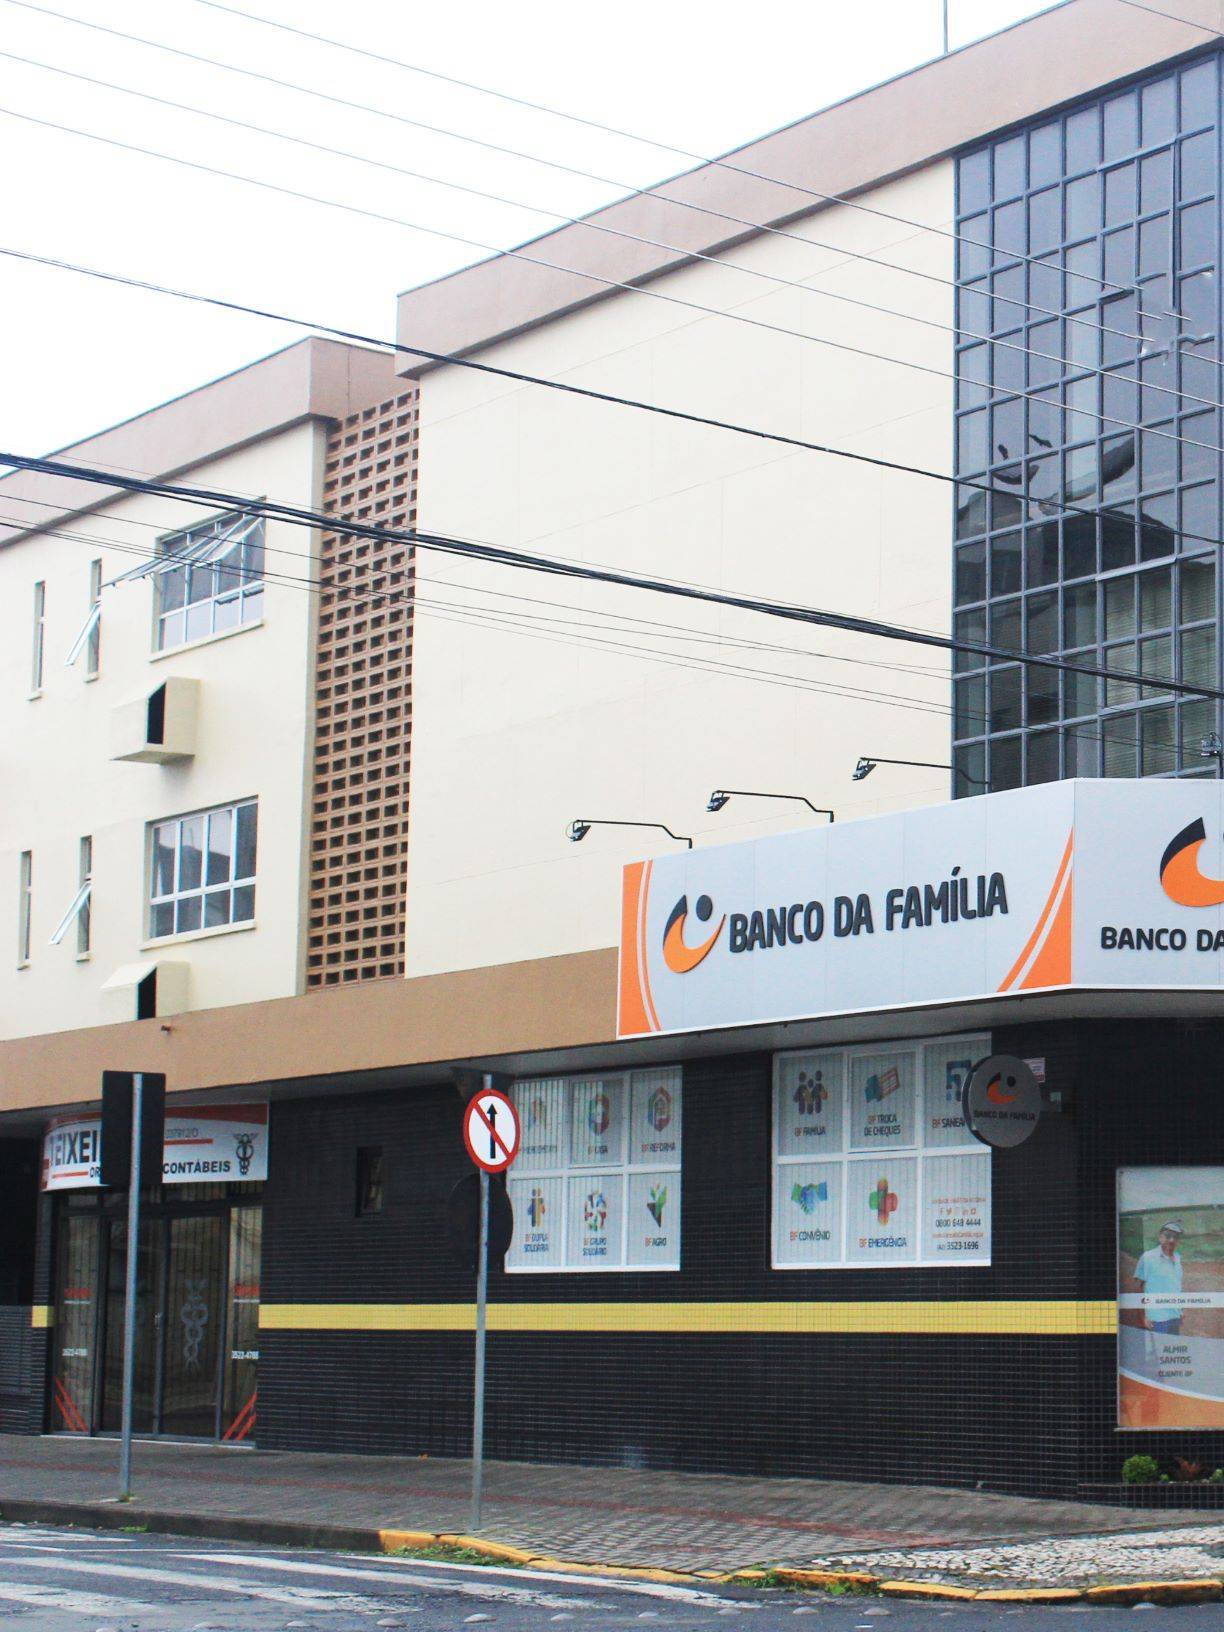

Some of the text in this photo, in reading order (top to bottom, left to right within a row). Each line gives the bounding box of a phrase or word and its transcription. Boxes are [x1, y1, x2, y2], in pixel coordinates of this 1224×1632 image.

[729, 866, 1008, 954] BANCO DA FAMÍLIA
[1100, 926, 1187, 952] BANCO
[163, 1160, 231, 1175] CONTÁBEIS
[1163, 1345, 1188, 1354] ALMIR
[1159, 1356, 1191, 1364] SANTOS
